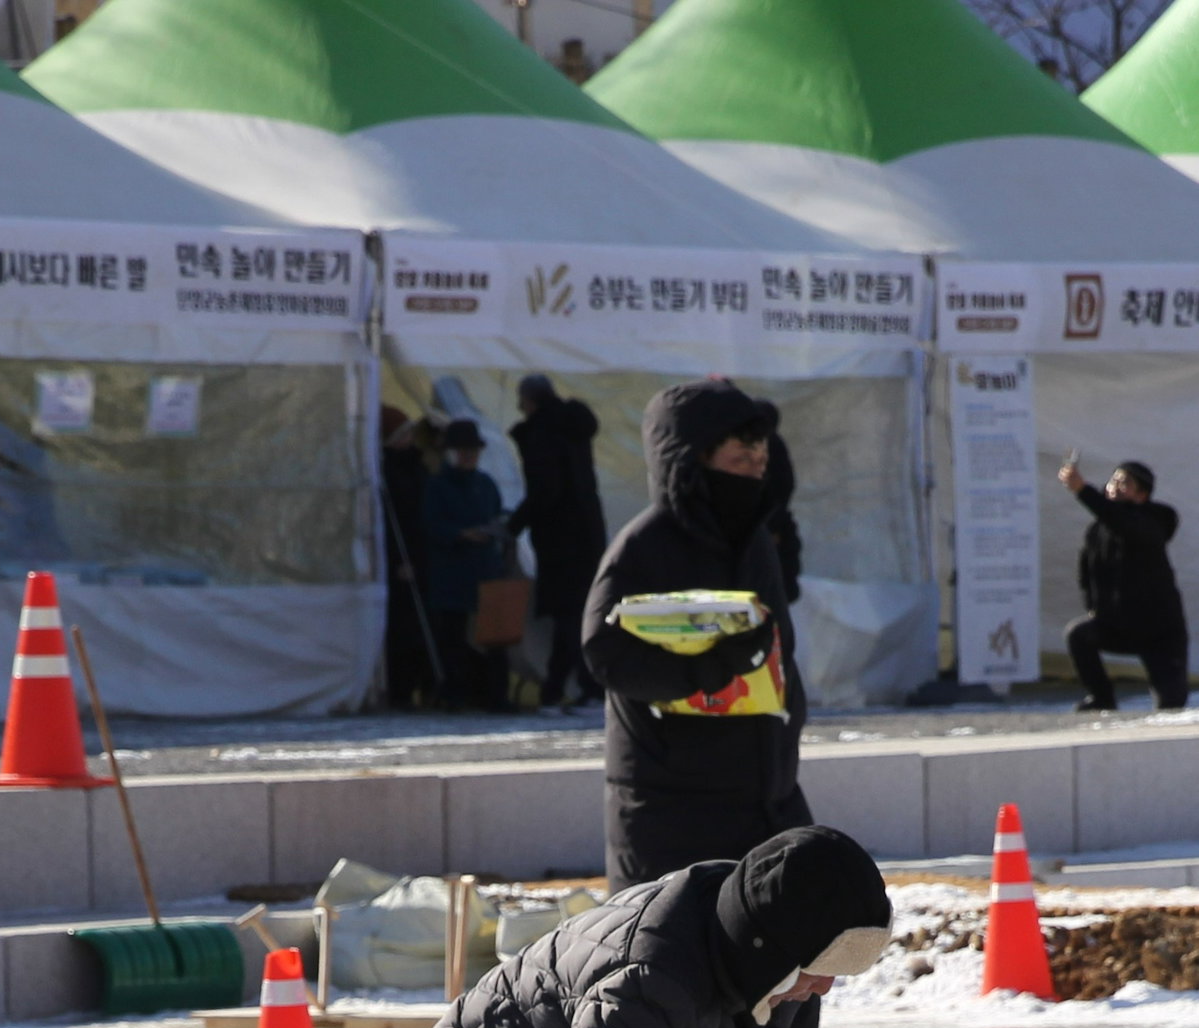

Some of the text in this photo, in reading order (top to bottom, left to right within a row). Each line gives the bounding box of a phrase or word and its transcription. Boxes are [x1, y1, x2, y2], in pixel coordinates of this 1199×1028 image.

[76, 253, 119, 291] 빠른
[126, 255, 148, 292] 발
[175, 241, 222, 279] 민속
[230, 245, 277, 281] 놀이
[283, 247, 353, 286] 만들기
[588, 274, 750, 314] 승부는 만들기 부터
[761, 264, 802, 301] 민속
[809, 268, 850, 303] 놀이
[854, 271, 915, 307] 만들기
[1119, 286, 1199, 328] 축제 안
